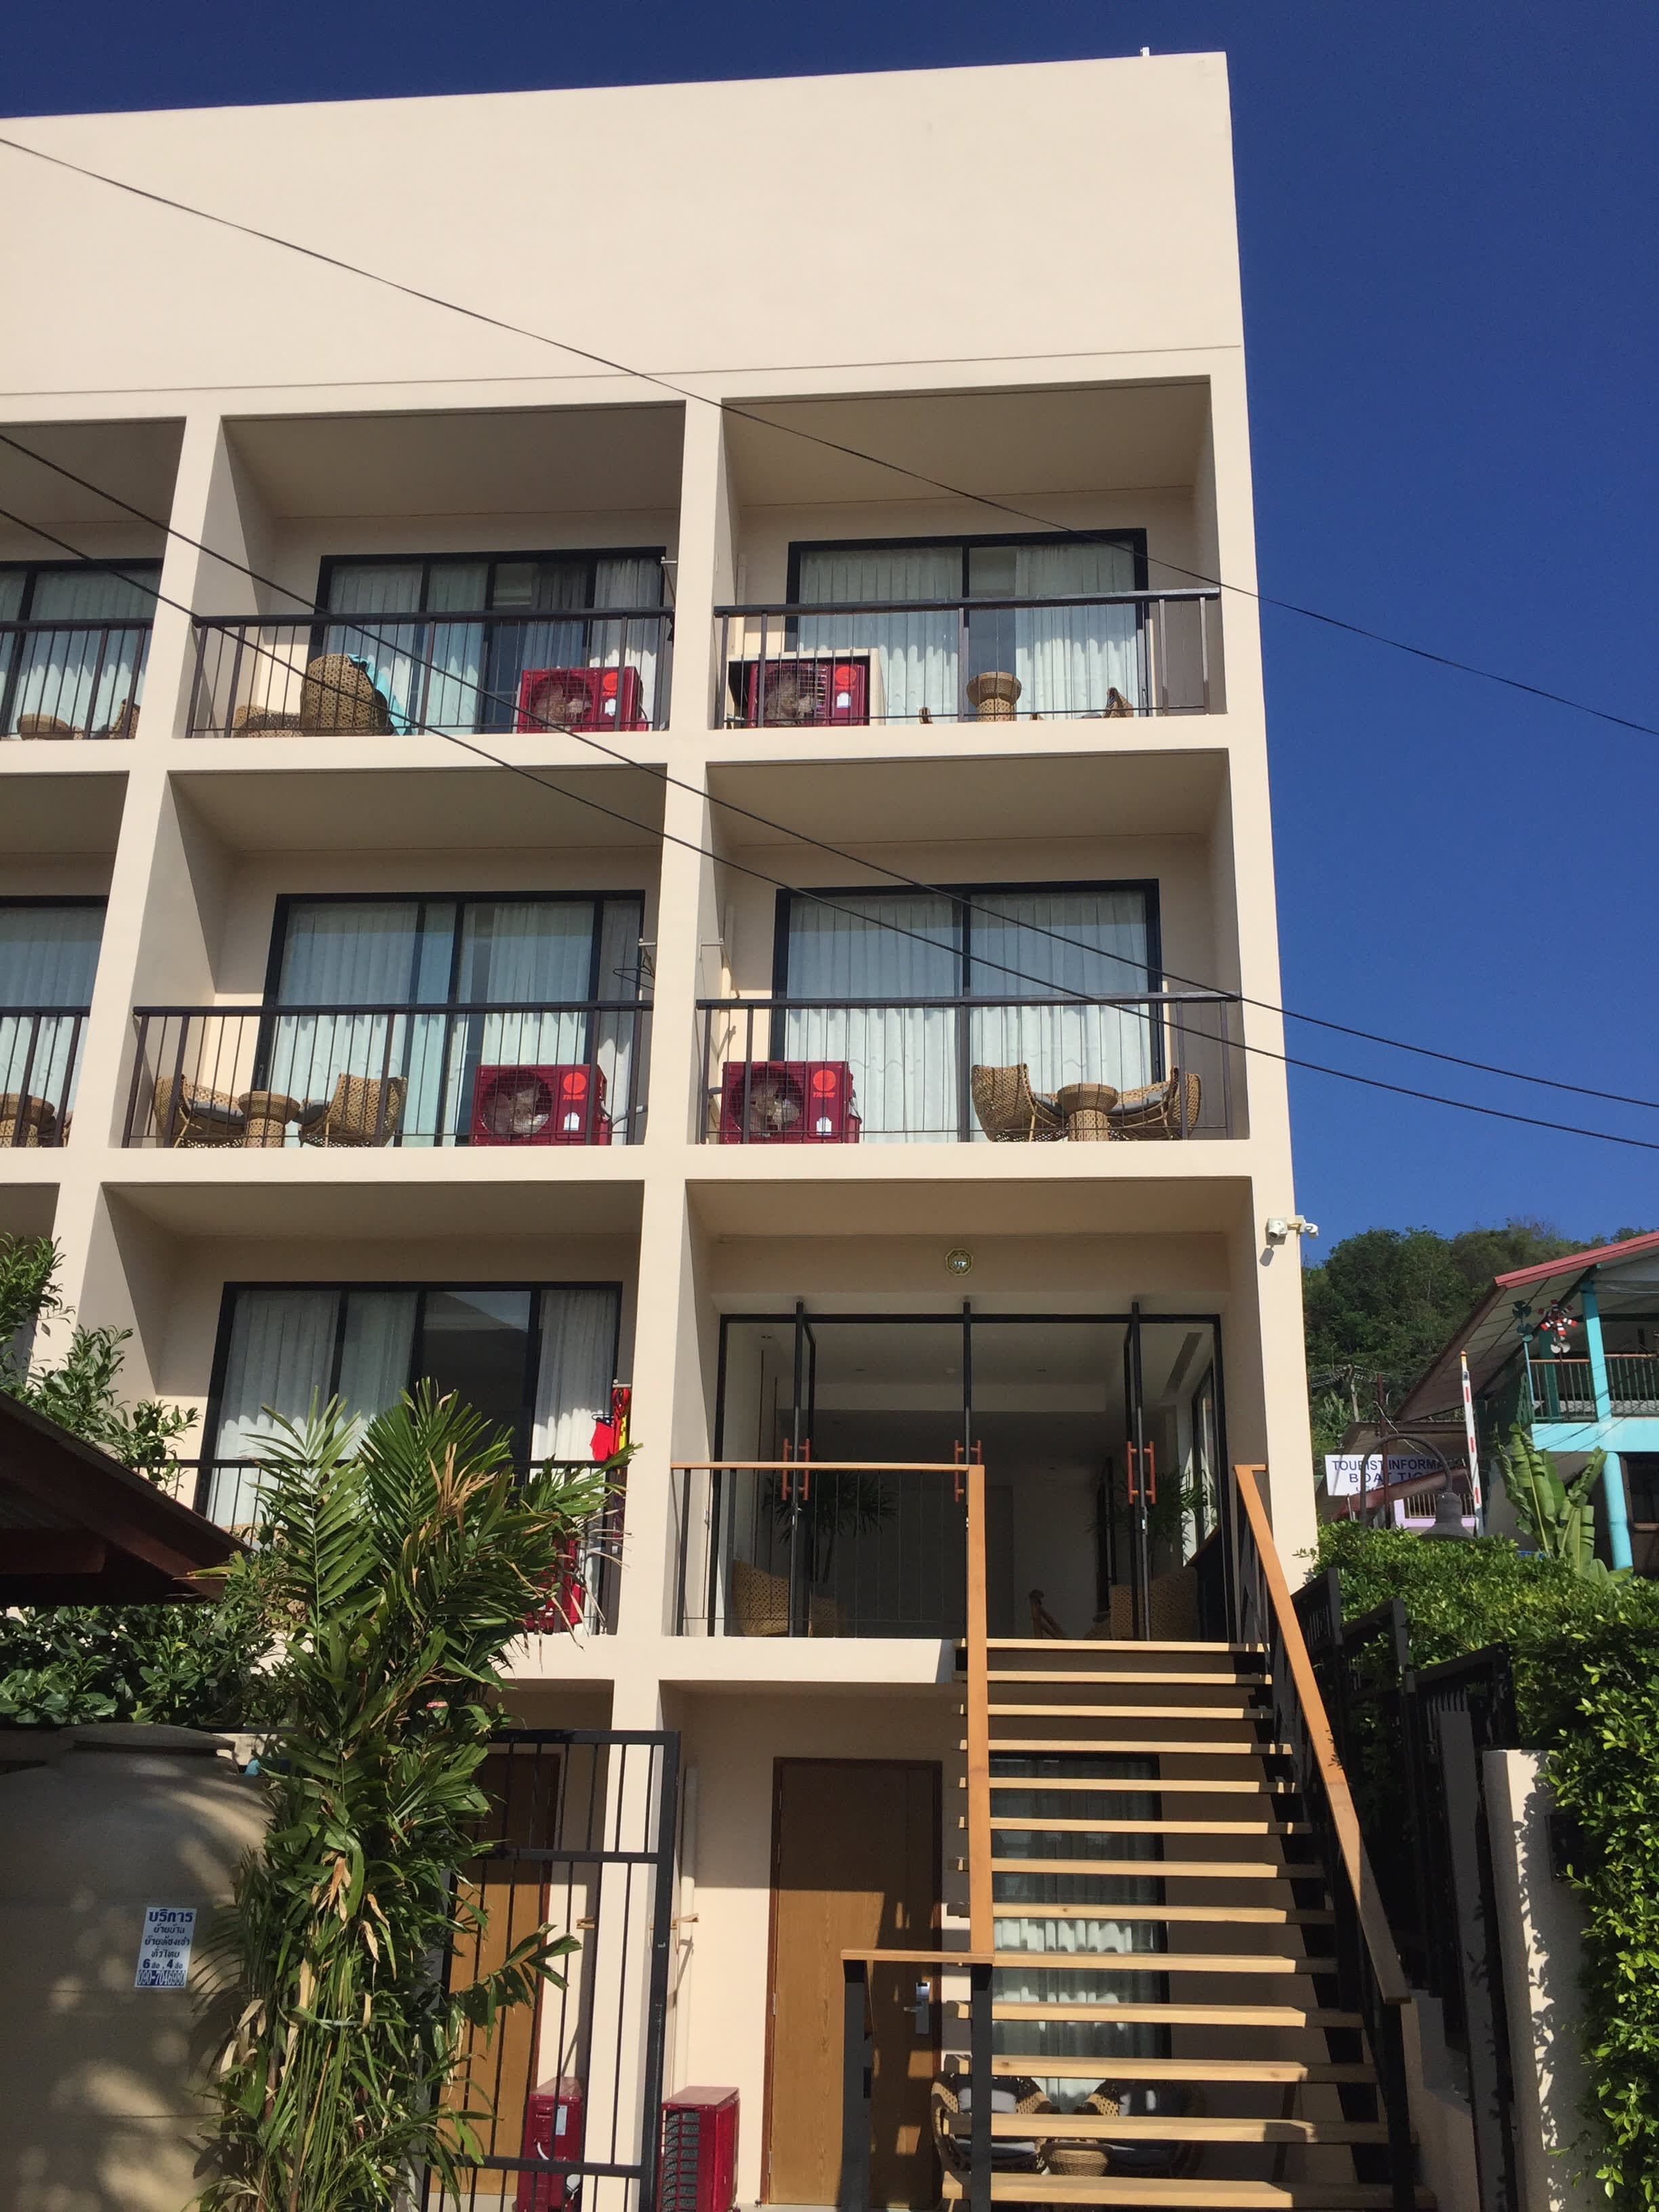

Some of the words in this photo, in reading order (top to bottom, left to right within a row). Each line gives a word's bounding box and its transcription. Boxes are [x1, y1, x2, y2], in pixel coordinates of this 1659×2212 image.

[149, 1908, 193, 1923] บริการ
[142, 1959, 150, 1969] 6
[167, 1959, 173, 1969] 4
